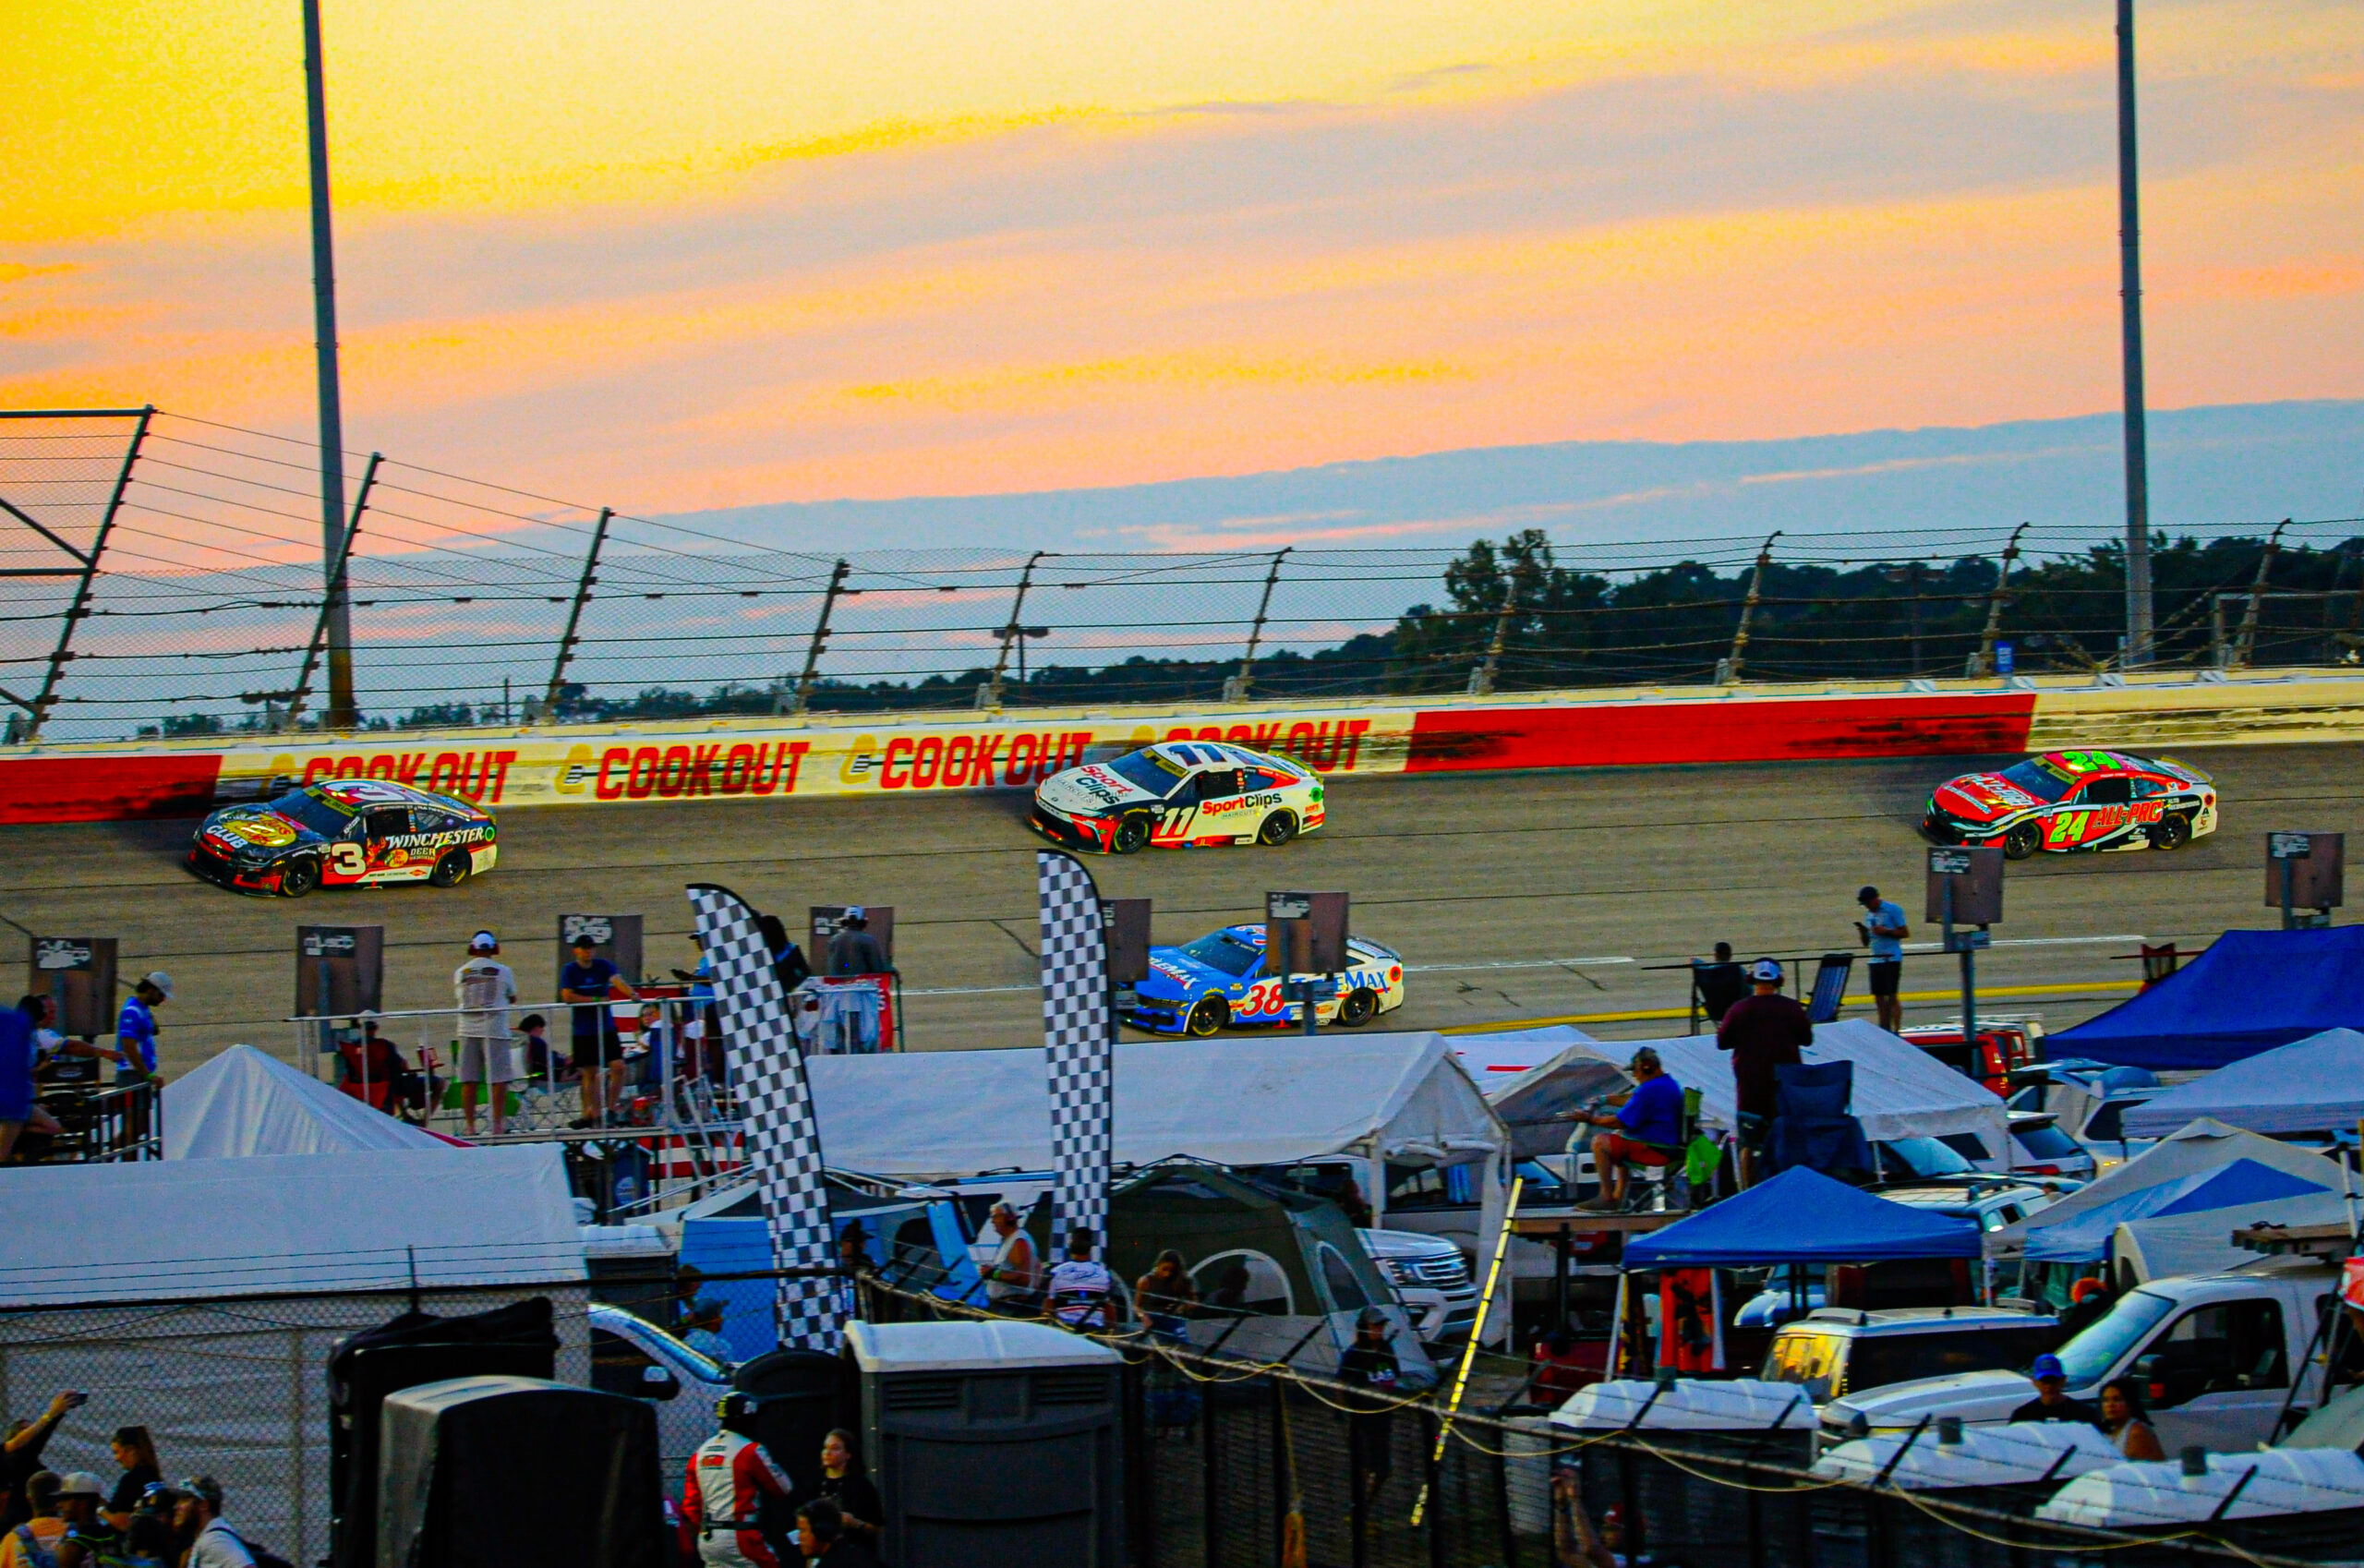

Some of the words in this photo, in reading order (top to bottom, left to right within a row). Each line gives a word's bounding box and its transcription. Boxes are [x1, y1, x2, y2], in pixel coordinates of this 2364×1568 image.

[596, 743, 721, 800] COOK
[720, 742, 811, 795] OUT
[880, 734, 1004, 789] COOK
[206, 825, 248, 850] CLUB
[1159, 806, 1196, 837] 11
[2048, 811, 2091, 843] 24
[385, 826, 485, 850] WINCHESTER
[332, 842, 368, 875] 3
[1241, 984, 1285, 1017] 38
